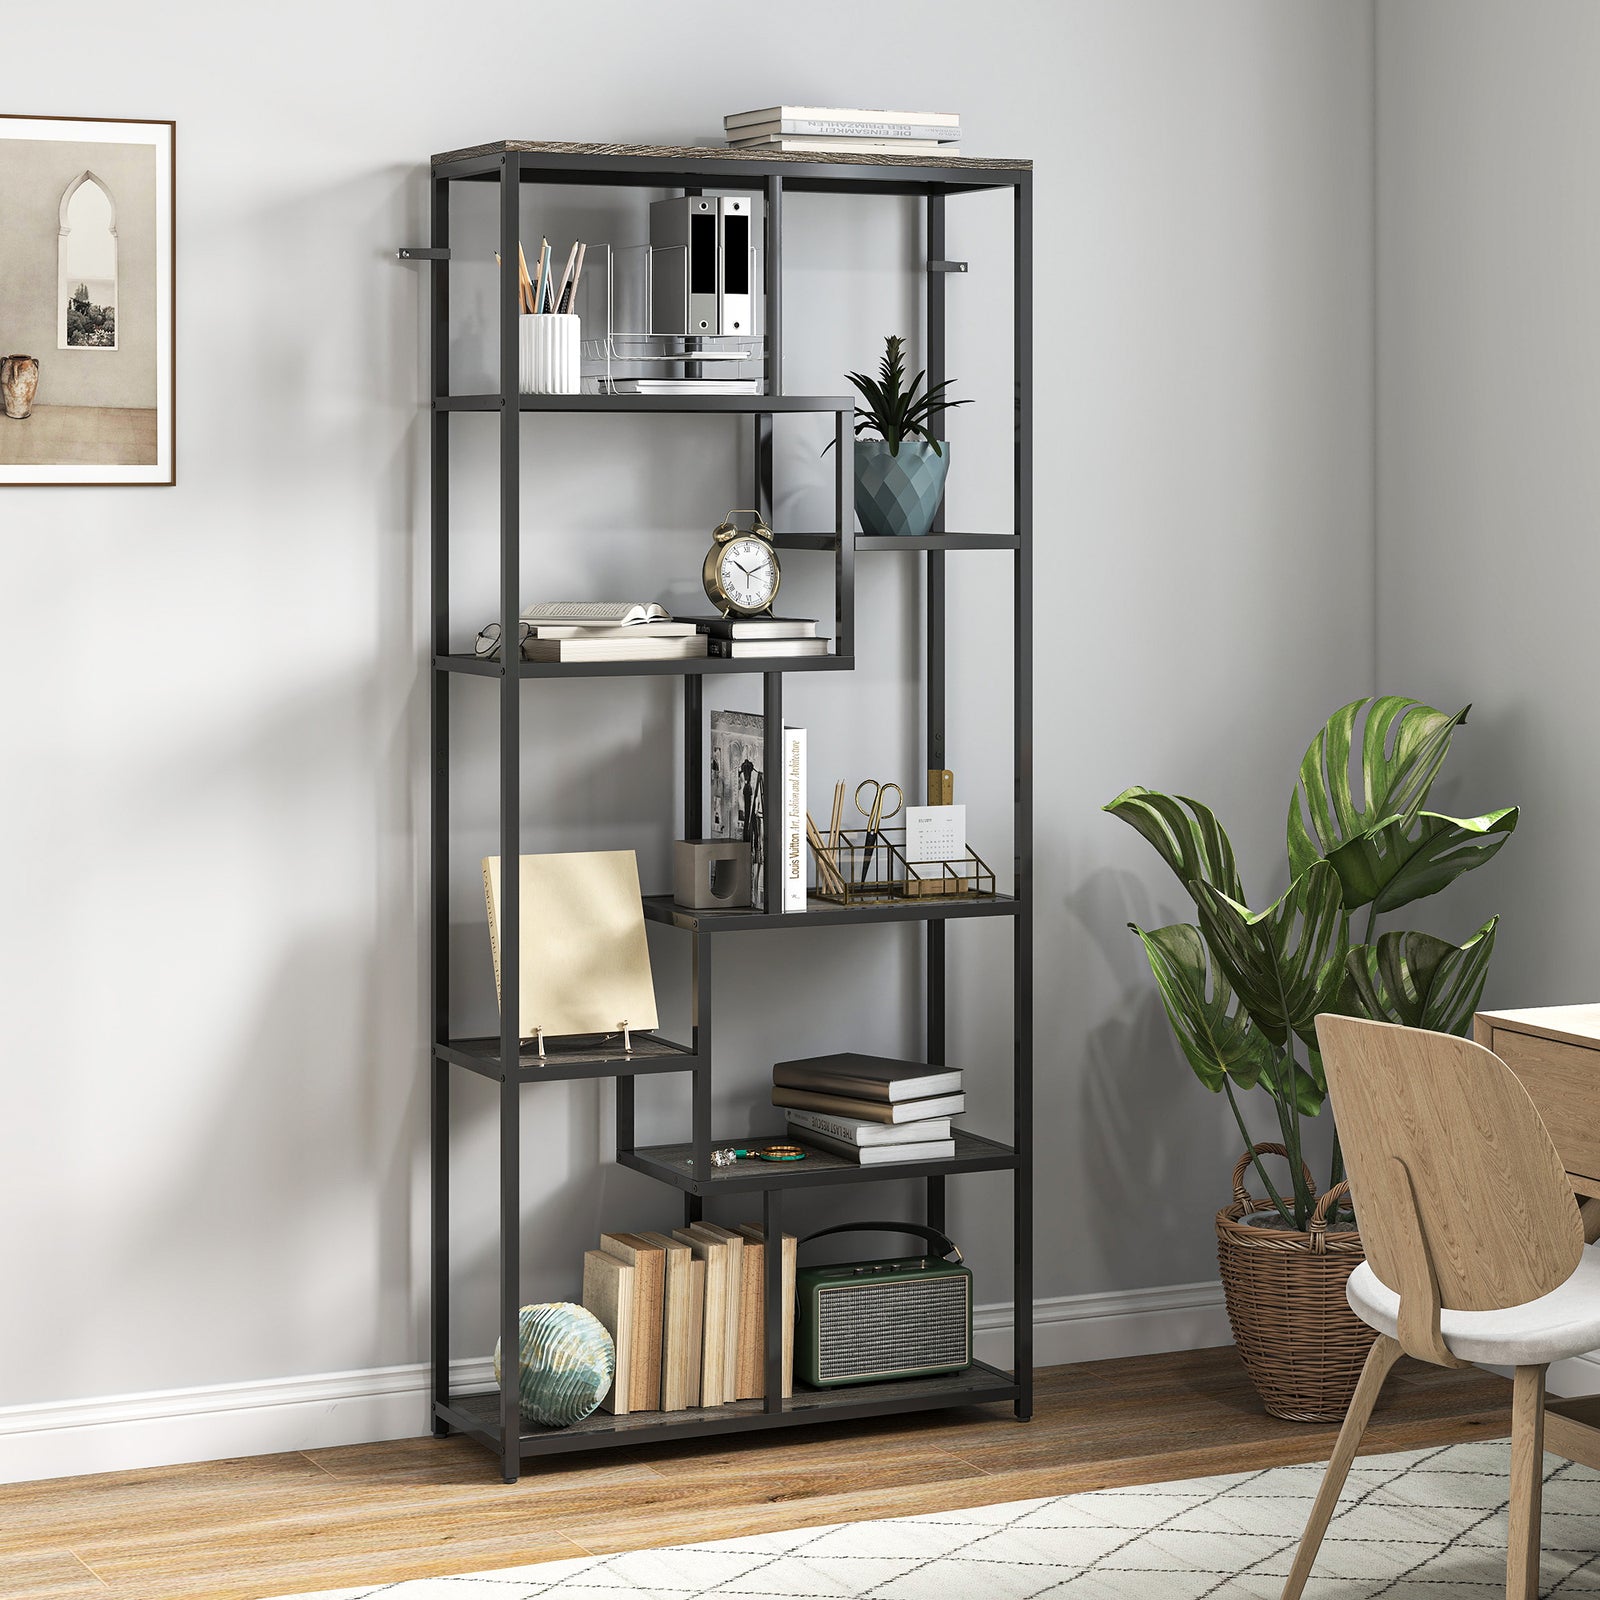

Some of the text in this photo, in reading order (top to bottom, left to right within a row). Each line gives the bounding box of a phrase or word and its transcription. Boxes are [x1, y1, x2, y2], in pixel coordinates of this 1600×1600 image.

[818, 127, 890, 136] EINSAMKEIT
[789, 740, 800, 779] Architecture
[789, 779, 800, 792] and
[789, 792, 800, 818] Fashion
[789, 833, 800, 858] Vuitton
[789, 859, 800, 880] Louis
[843, 1127, 853, 1140] THE
